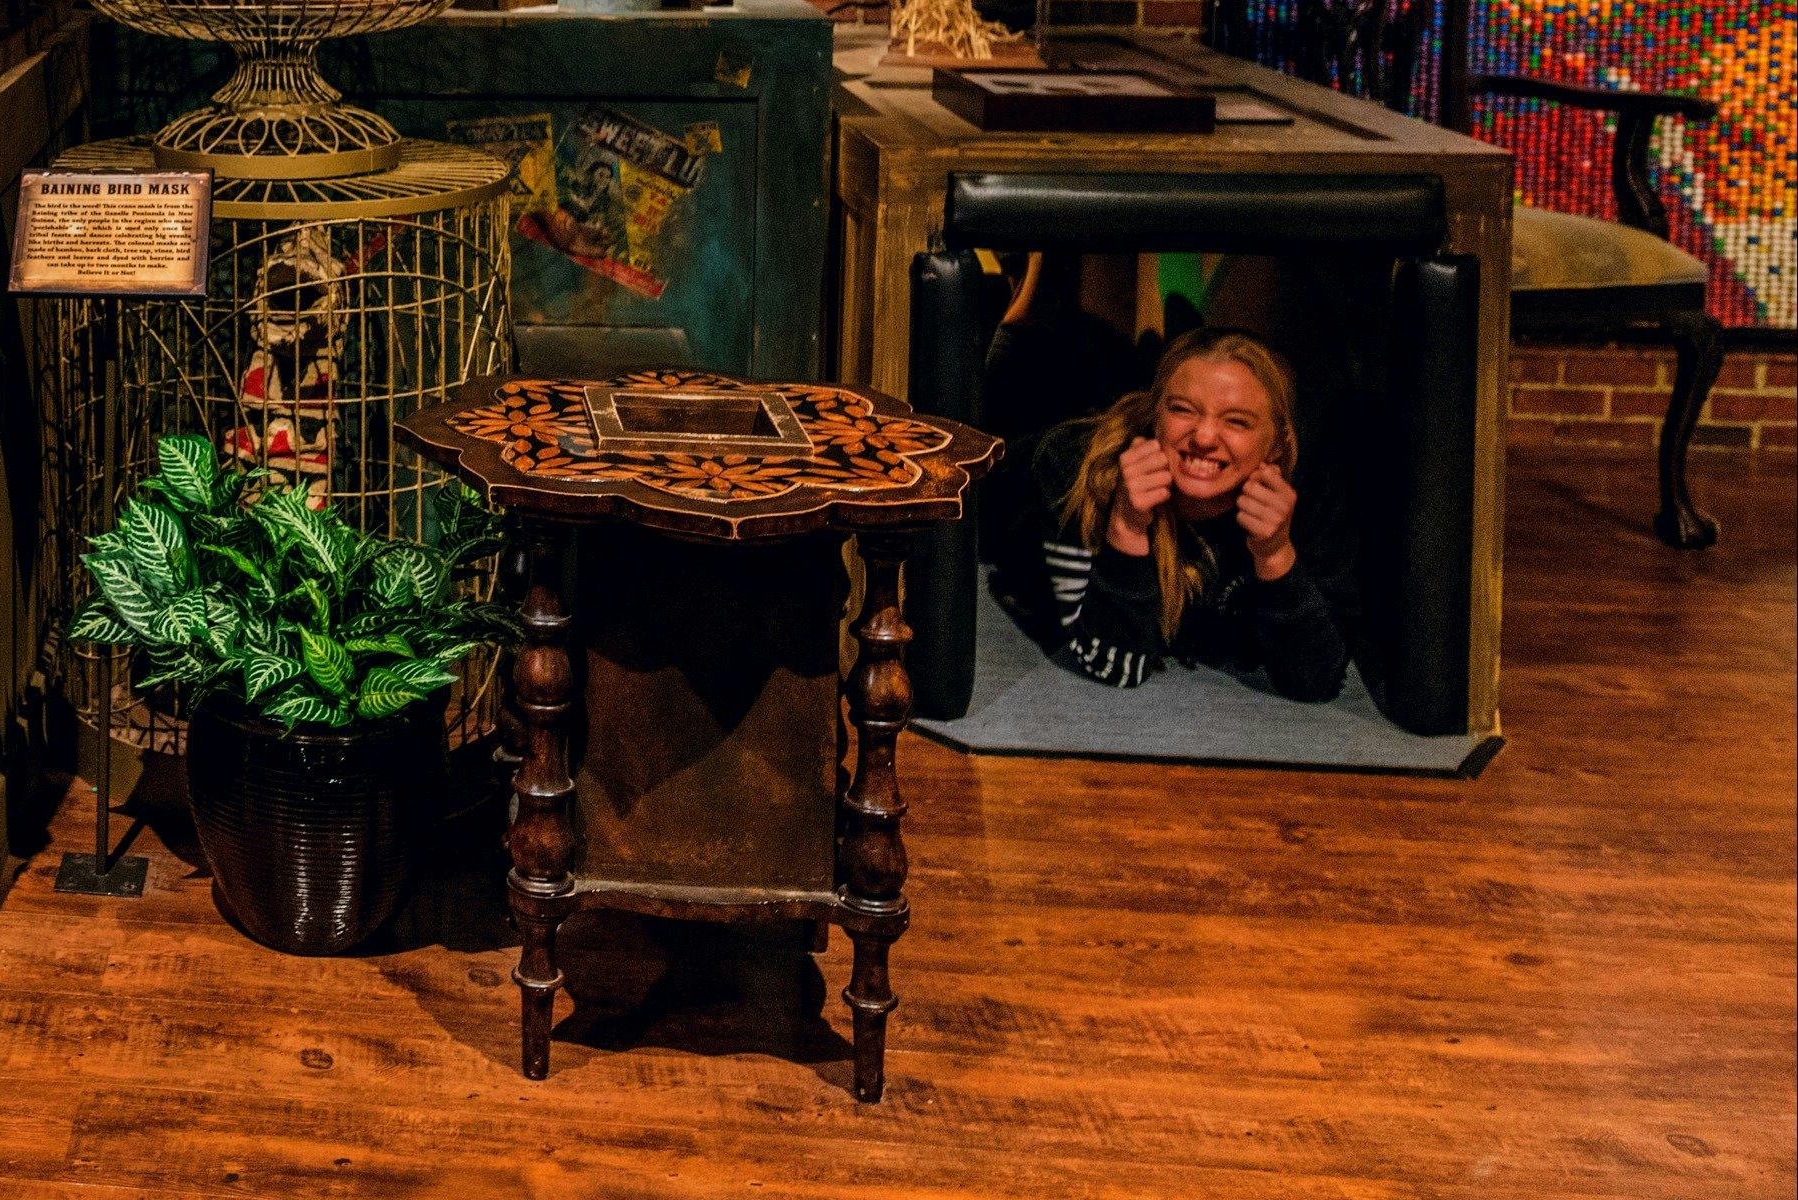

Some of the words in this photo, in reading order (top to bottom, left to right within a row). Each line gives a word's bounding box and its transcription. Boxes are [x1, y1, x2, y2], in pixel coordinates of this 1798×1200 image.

[41, 183, 101, 195] BAINING
[108, 183, 142, 195] BIRD
[148, 183, 190, 195] MASK
